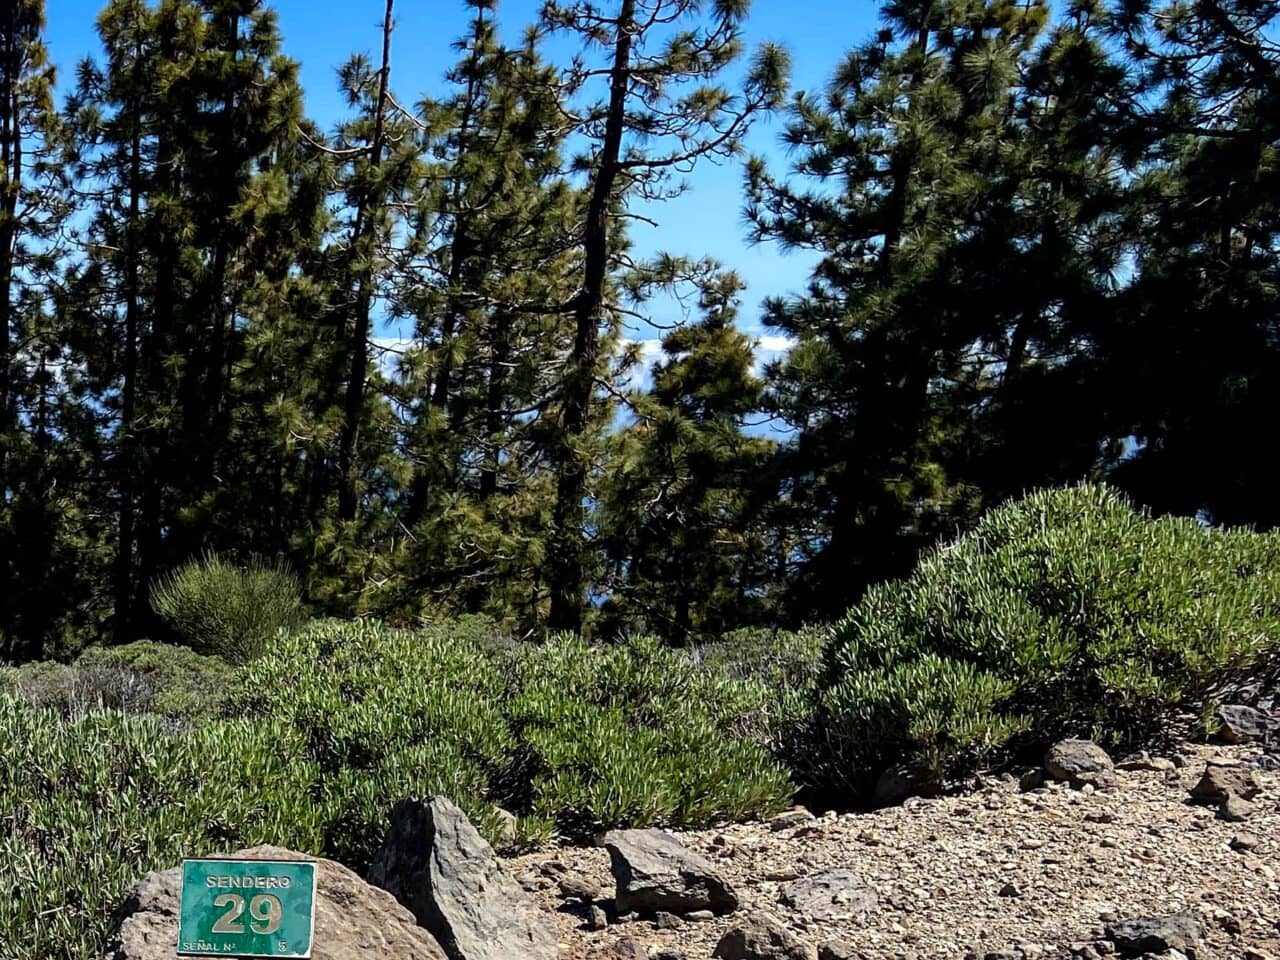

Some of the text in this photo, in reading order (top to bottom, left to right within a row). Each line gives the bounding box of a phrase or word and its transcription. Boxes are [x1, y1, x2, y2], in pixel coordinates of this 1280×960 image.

[206, 875, 292, 889] SENDERO
[211, 893, 283, 935] 29
[183, 939, 220, 952] SEÑAL
